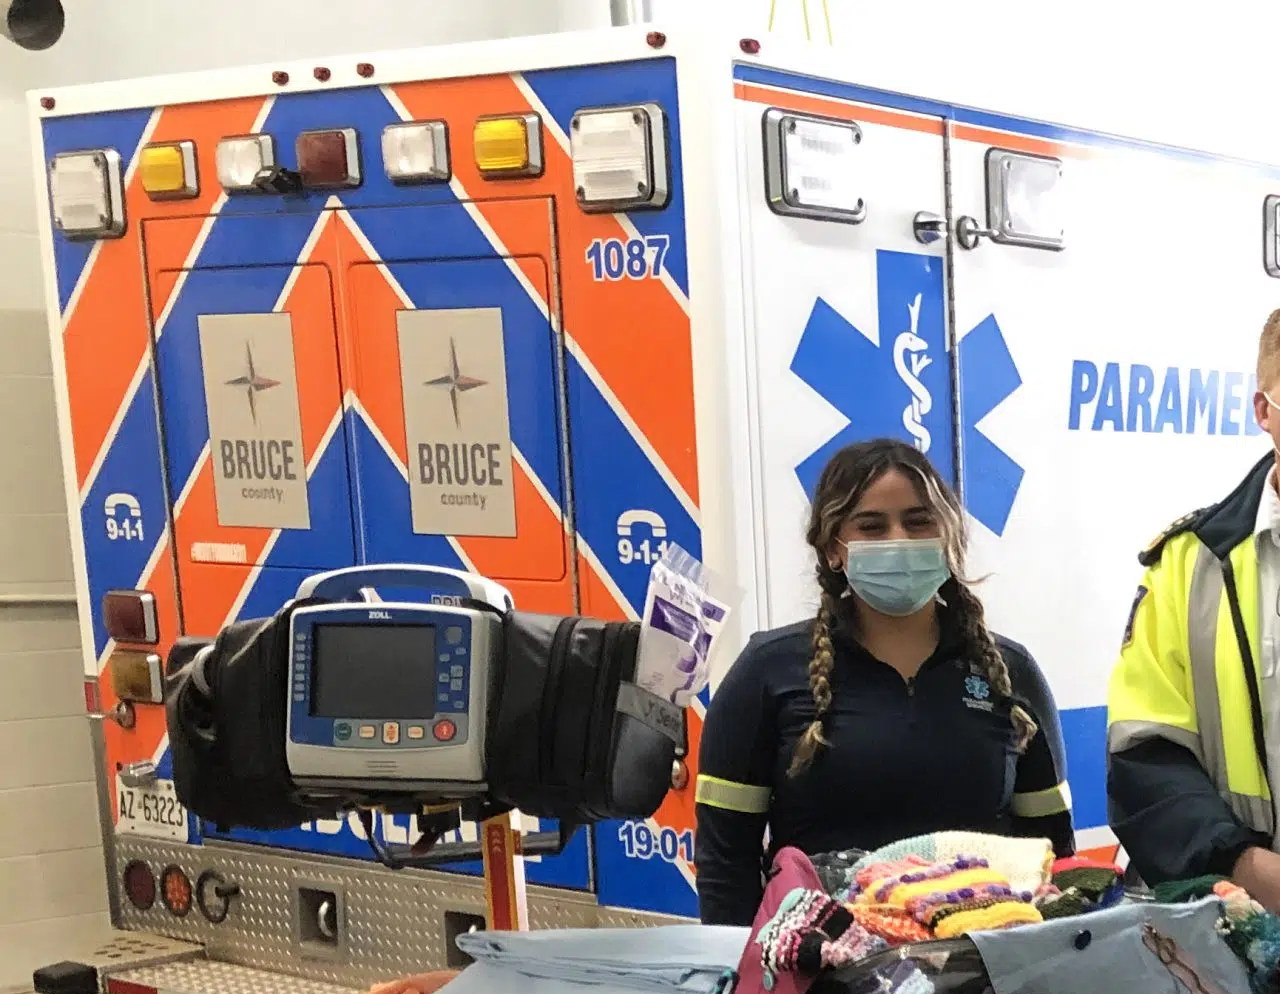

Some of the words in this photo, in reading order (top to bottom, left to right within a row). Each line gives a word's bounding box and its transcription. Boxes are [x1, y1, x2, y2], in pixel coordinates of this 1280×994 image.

[585, 235, 670, 281] 1087
[220, 439, 297, 480] BRUCE
[418, 443, 503, 486] BRUCE
[241, 486, 284, 504] county
[440, 492, 486, 511] county
[106, 518, 145, 541] 9-1-1
[617, 538, 668, 564] 9-1-1
[120, 790, 136, 819] AZ
[143, 794, 184, 827] 63223
